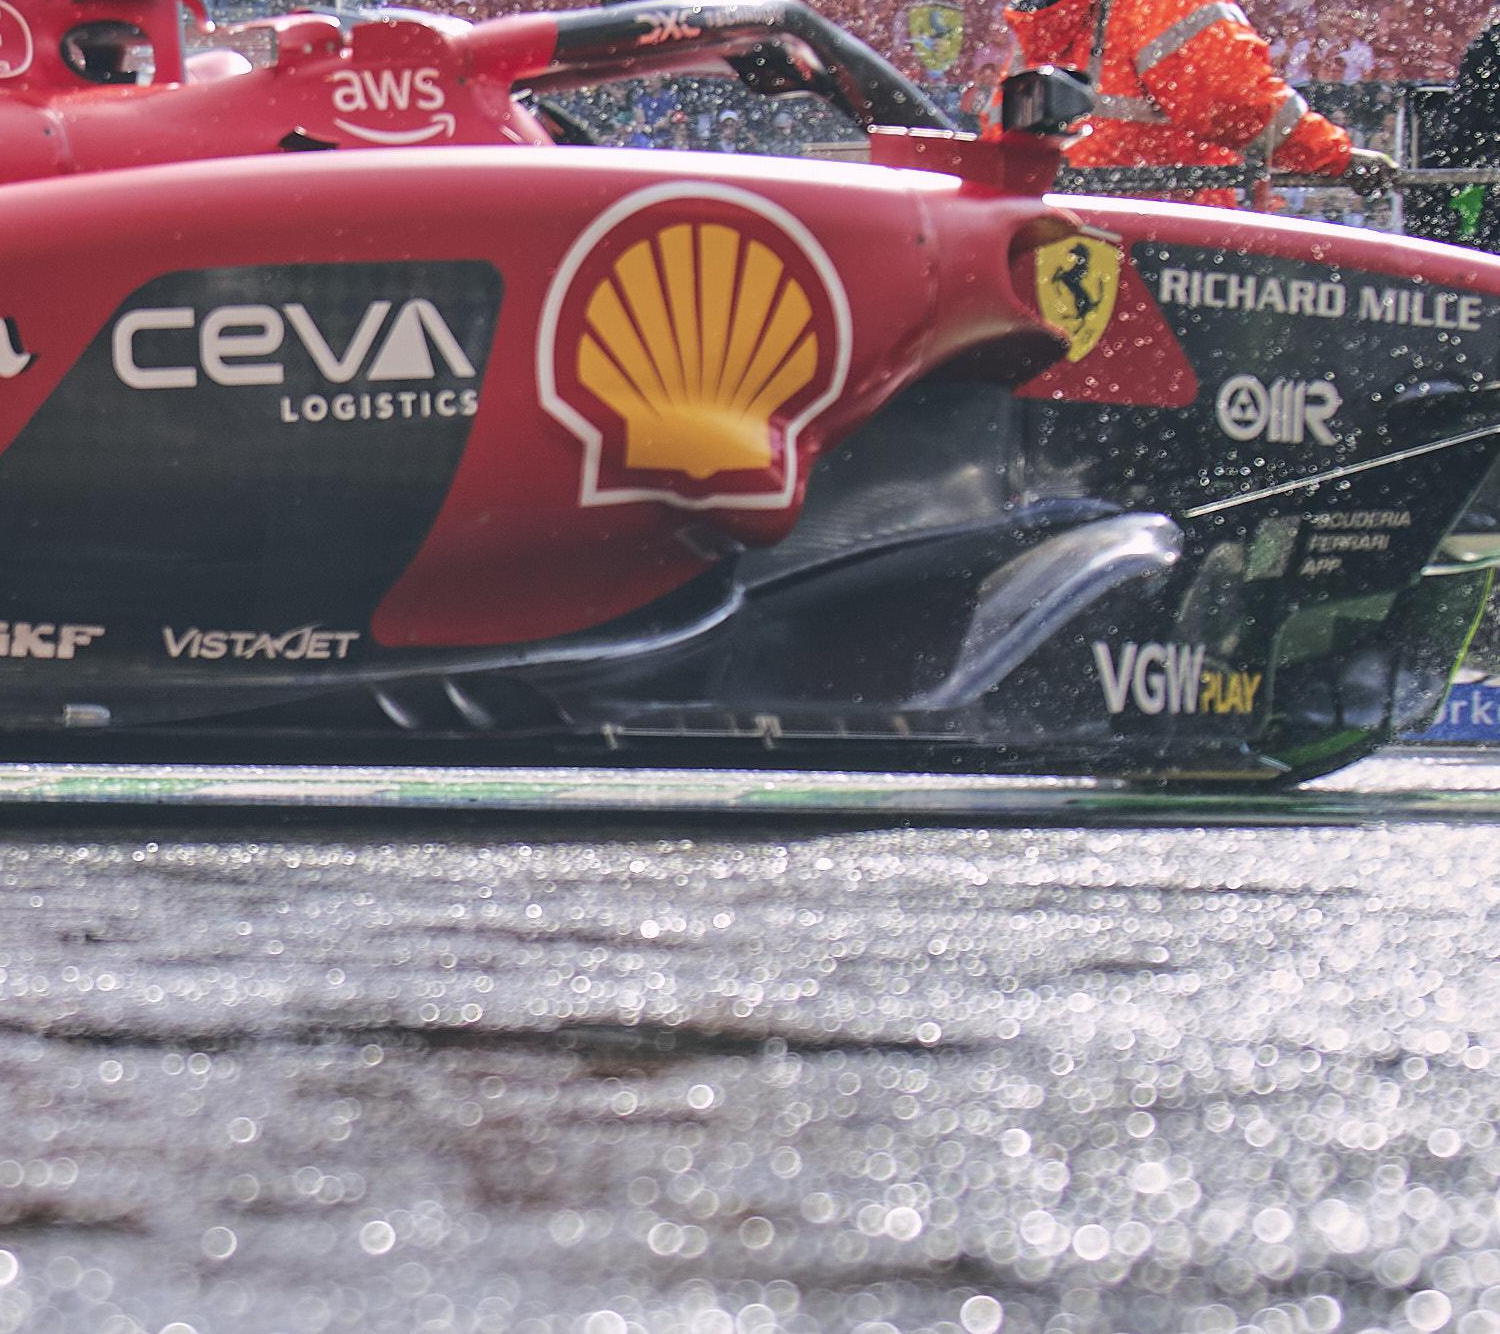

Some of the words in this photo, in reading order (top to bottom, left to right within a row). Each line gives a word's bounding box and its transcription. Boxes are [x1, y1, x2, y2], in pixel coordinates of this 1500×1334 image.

[331, 67, 445, 113] aws
[1158, 267, 1347, 318] RICHARD
[1358, 284, 1483, 332] MILLE
[280, 387, 479, 423] LOGISTICS
[163, 622, 362, 660] VISTAJET
[1092, 640, 1206, 715] VGW
[1200, 670, 1262, 716] PLAY
